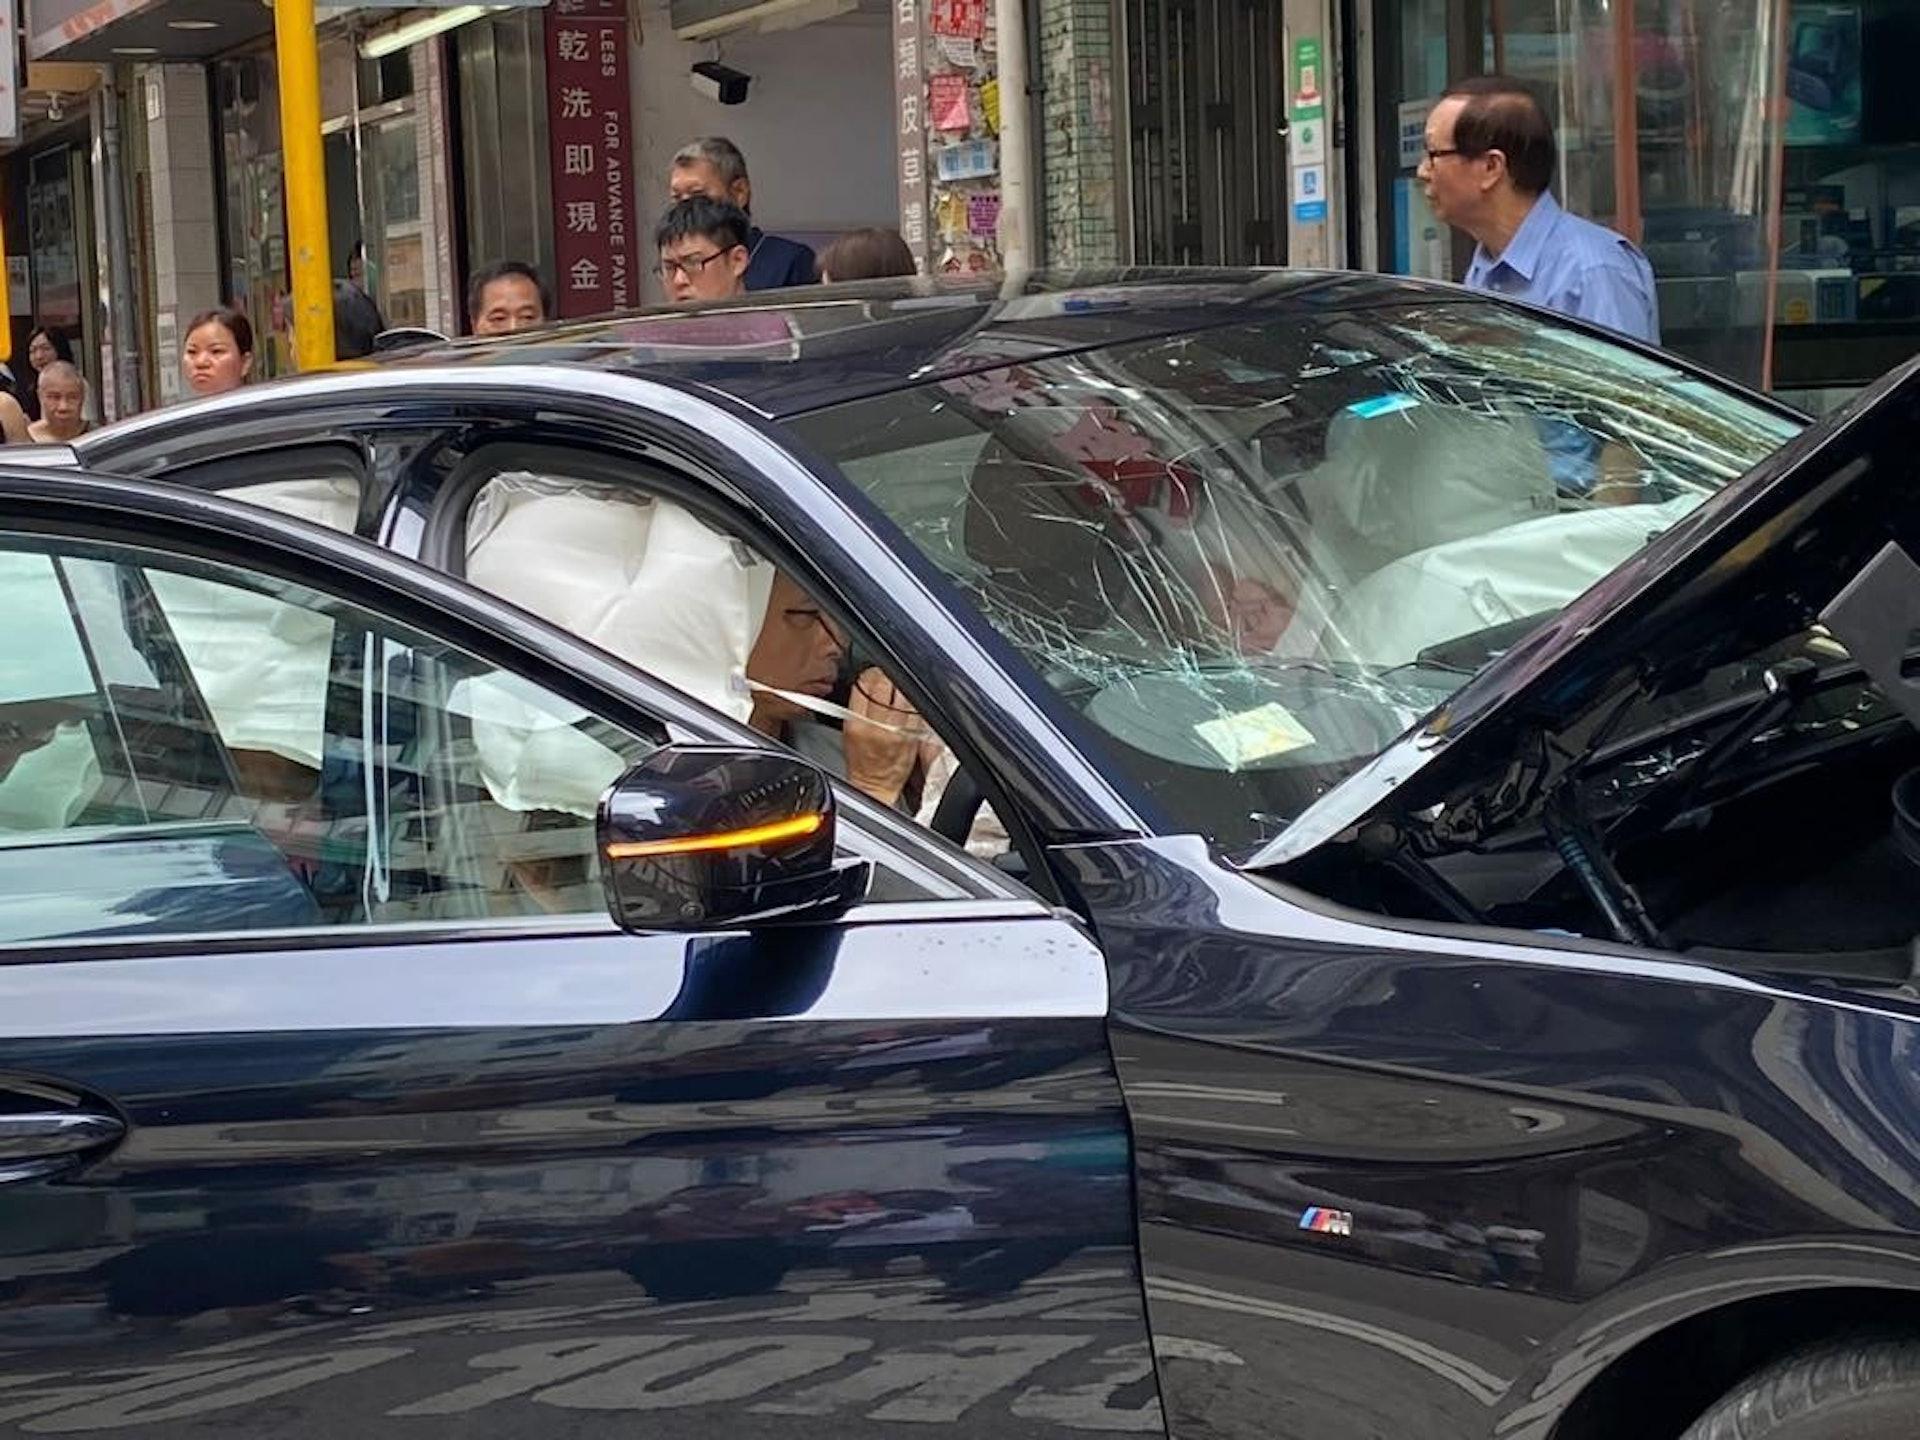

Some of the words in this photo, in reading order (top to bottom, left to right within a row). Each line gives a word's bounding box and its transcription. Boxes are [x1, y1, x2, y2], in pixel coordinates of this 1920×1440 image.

[600, 28, 617, 77] LESS
[557, 29, 600, 290] 乾洗即現金
[603, 110, 620, 150] FOR
[605, 156, 626, 247] ADVANCE
[610, 253, 628, 312] PAYM
